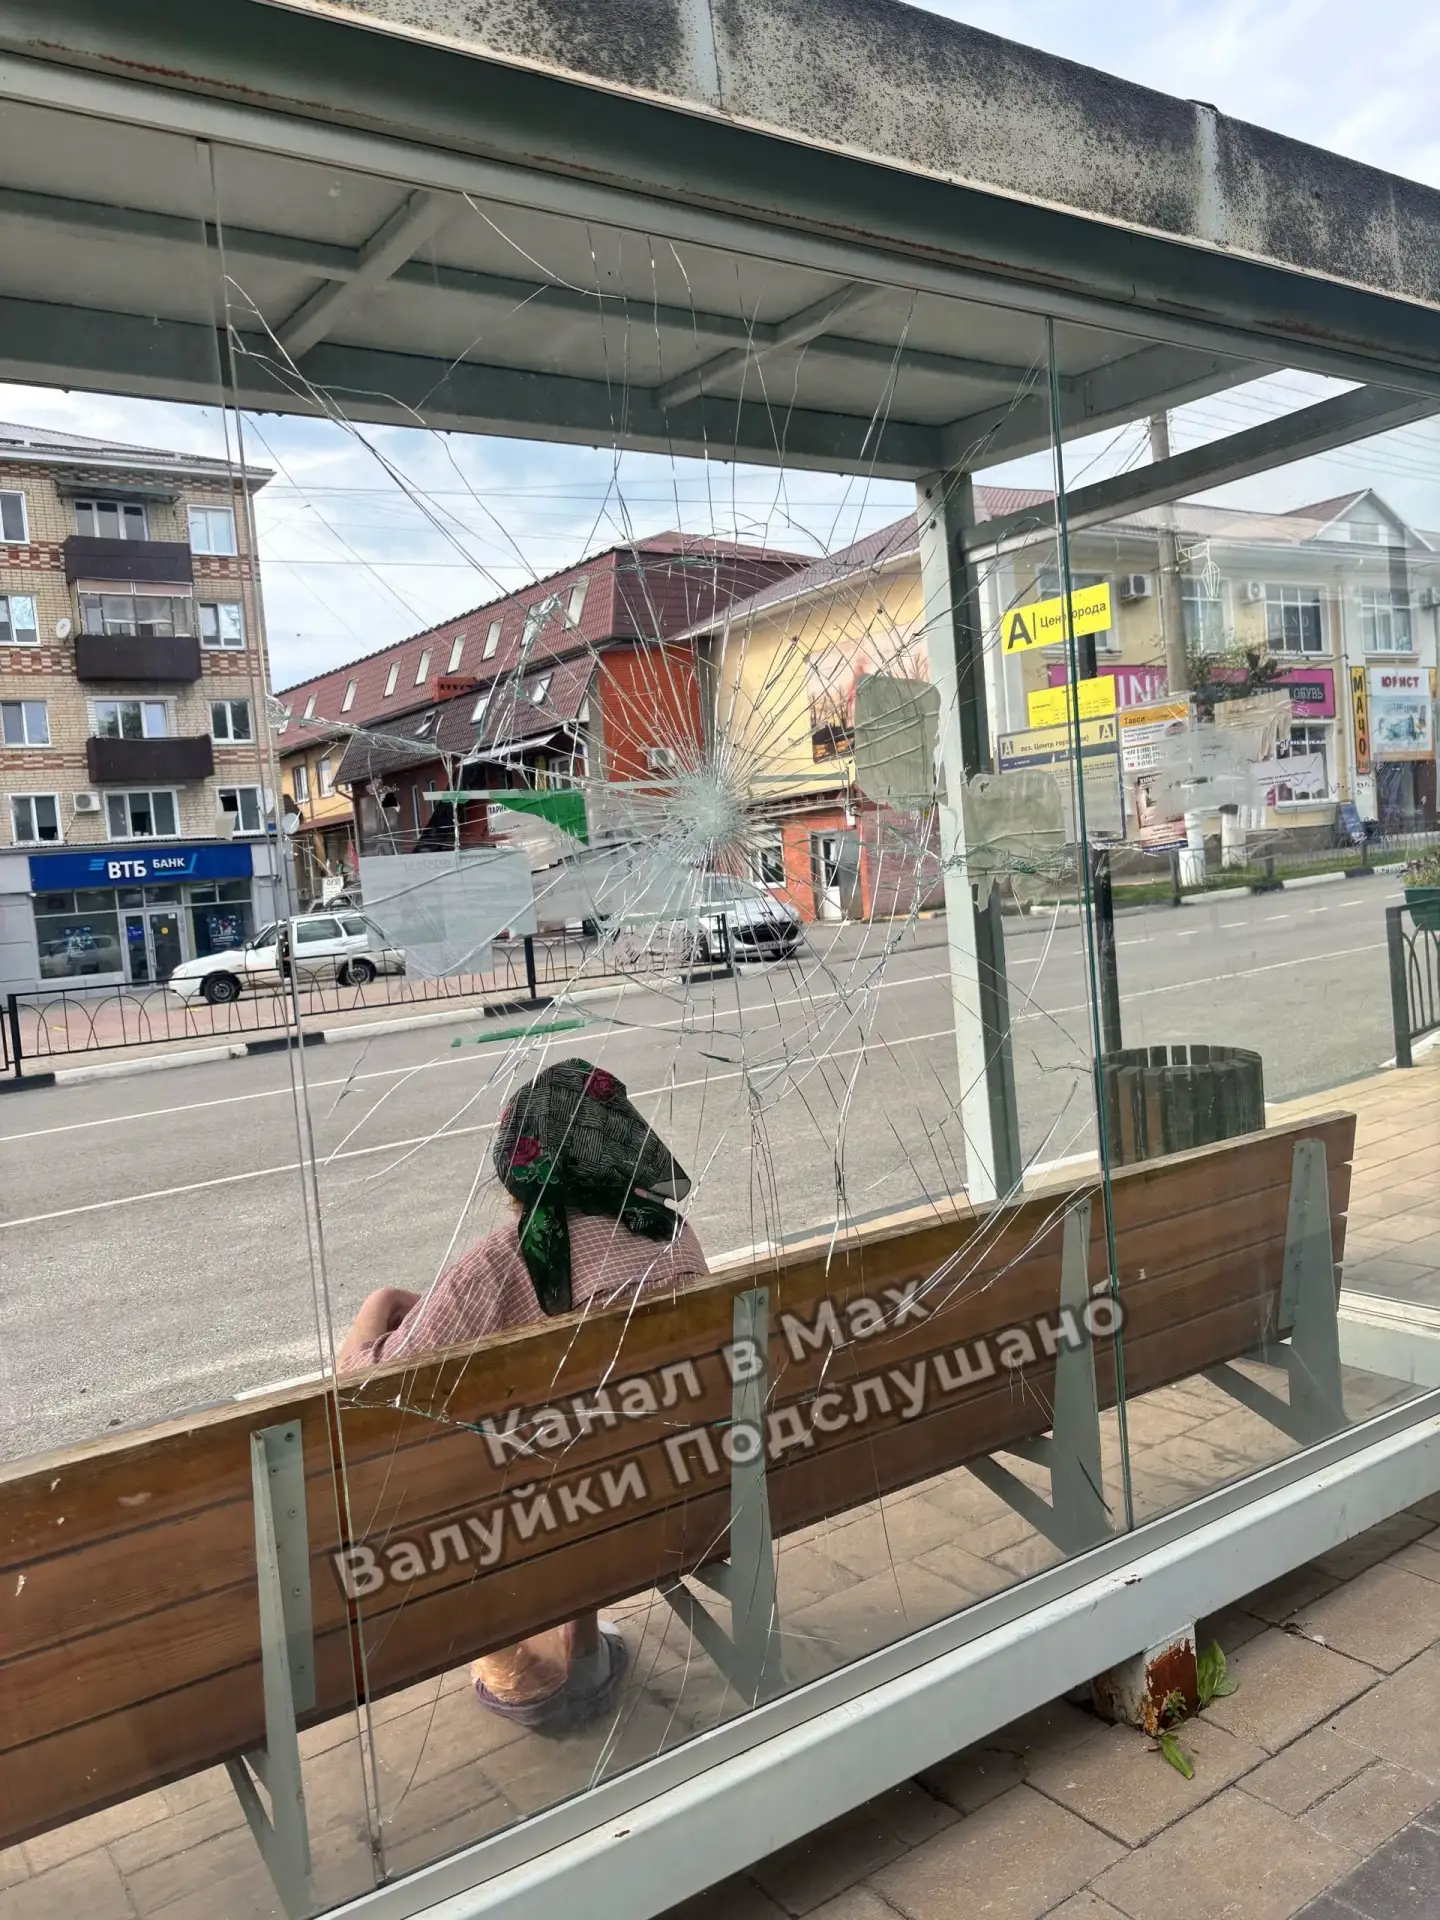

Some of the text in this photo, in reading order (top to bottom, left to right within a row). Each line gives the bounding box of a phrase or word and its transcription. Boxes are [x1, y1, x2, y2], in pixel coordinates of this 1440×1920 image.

[1293, 687, 1324, 700] ОБУВЬ
[1124, 716, 1145, 725] Такси
[1352, 675, 1367, 755] МАЧО
[107, 857, 186, 879] ВТБ БАНК
